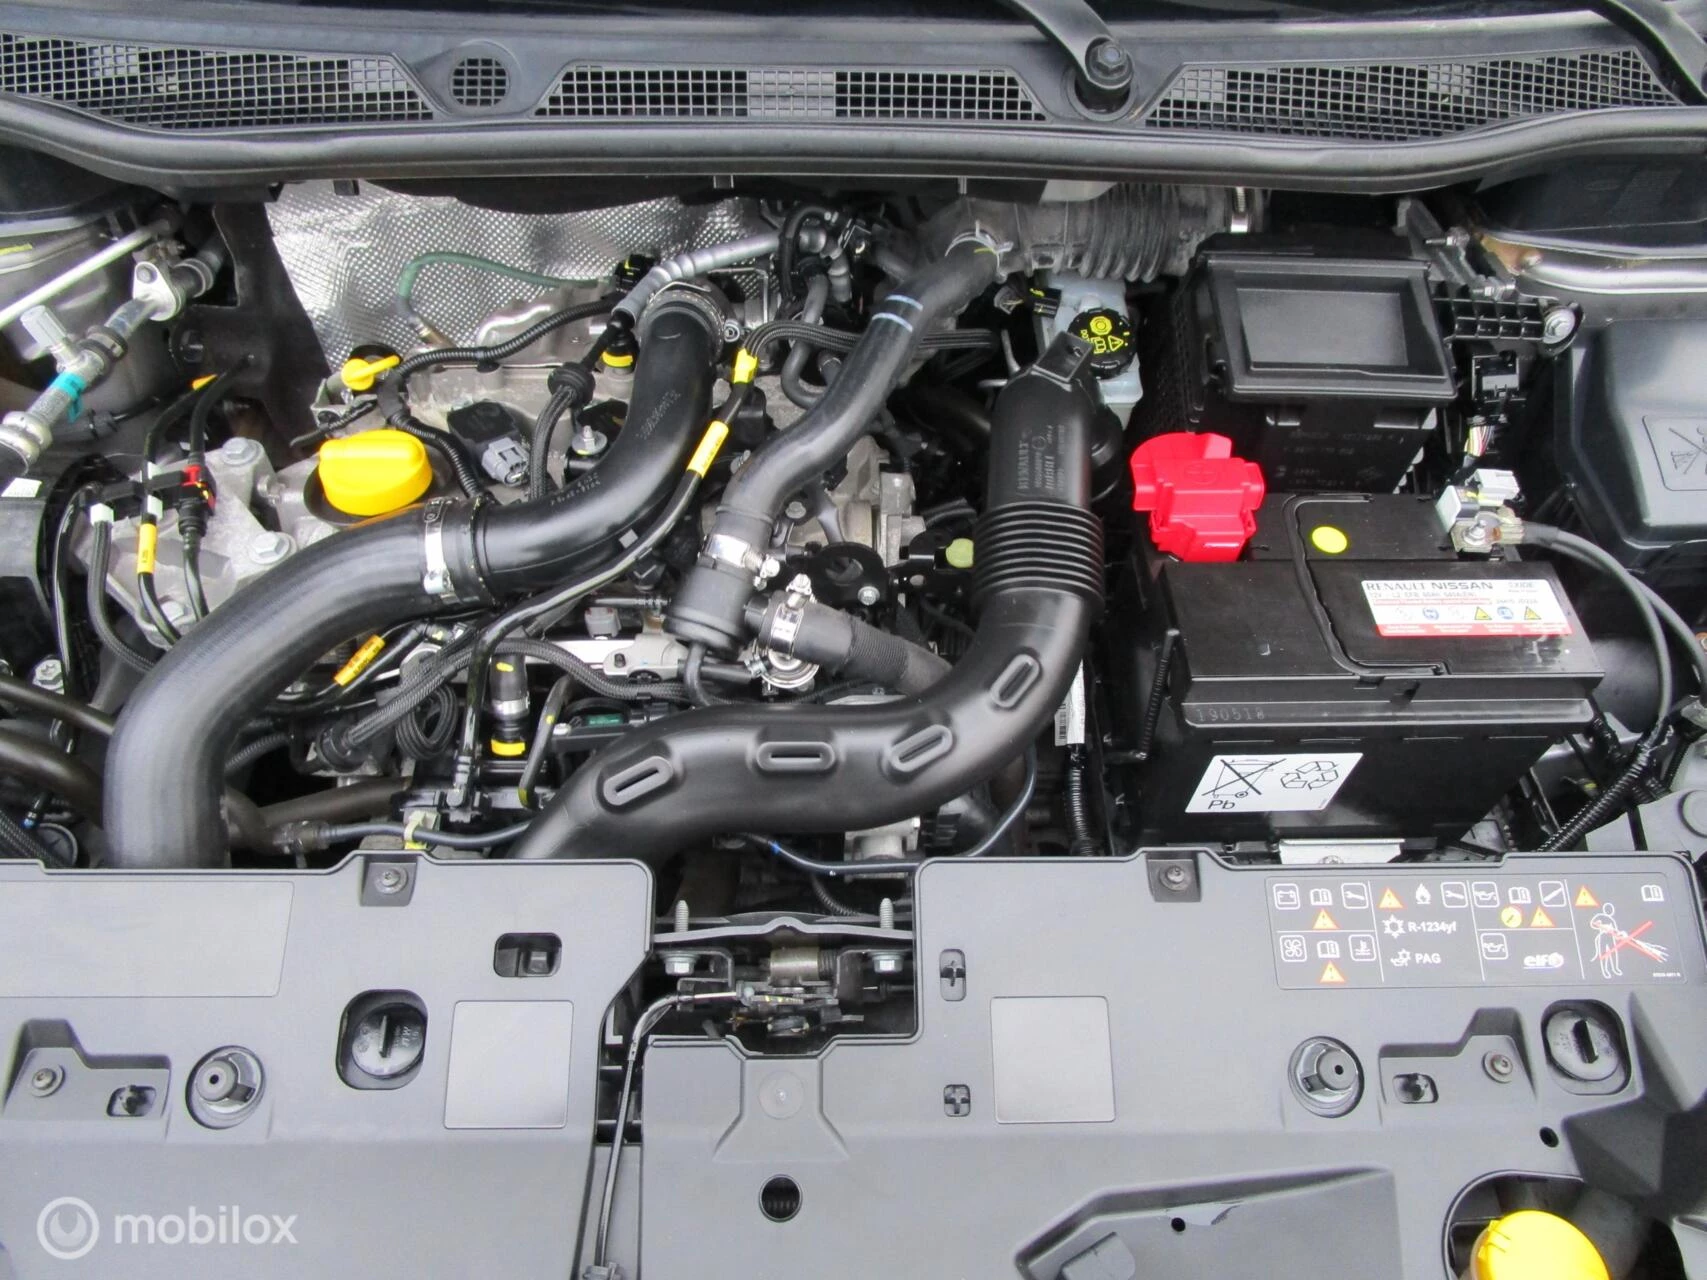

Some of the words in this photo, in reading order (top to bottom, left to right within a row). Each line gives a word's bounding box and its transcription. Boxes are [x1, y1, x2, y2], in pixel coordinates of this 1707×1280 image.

[1366, 582, 1426, 591] RENAULT
[1431, 581, 1493, 590] NISSAN
[1207, 799, 1236, 810] Pb
[1407, 919, 1458, 934] R-1234yf
[1415, 952, 1442, 965] PAG
